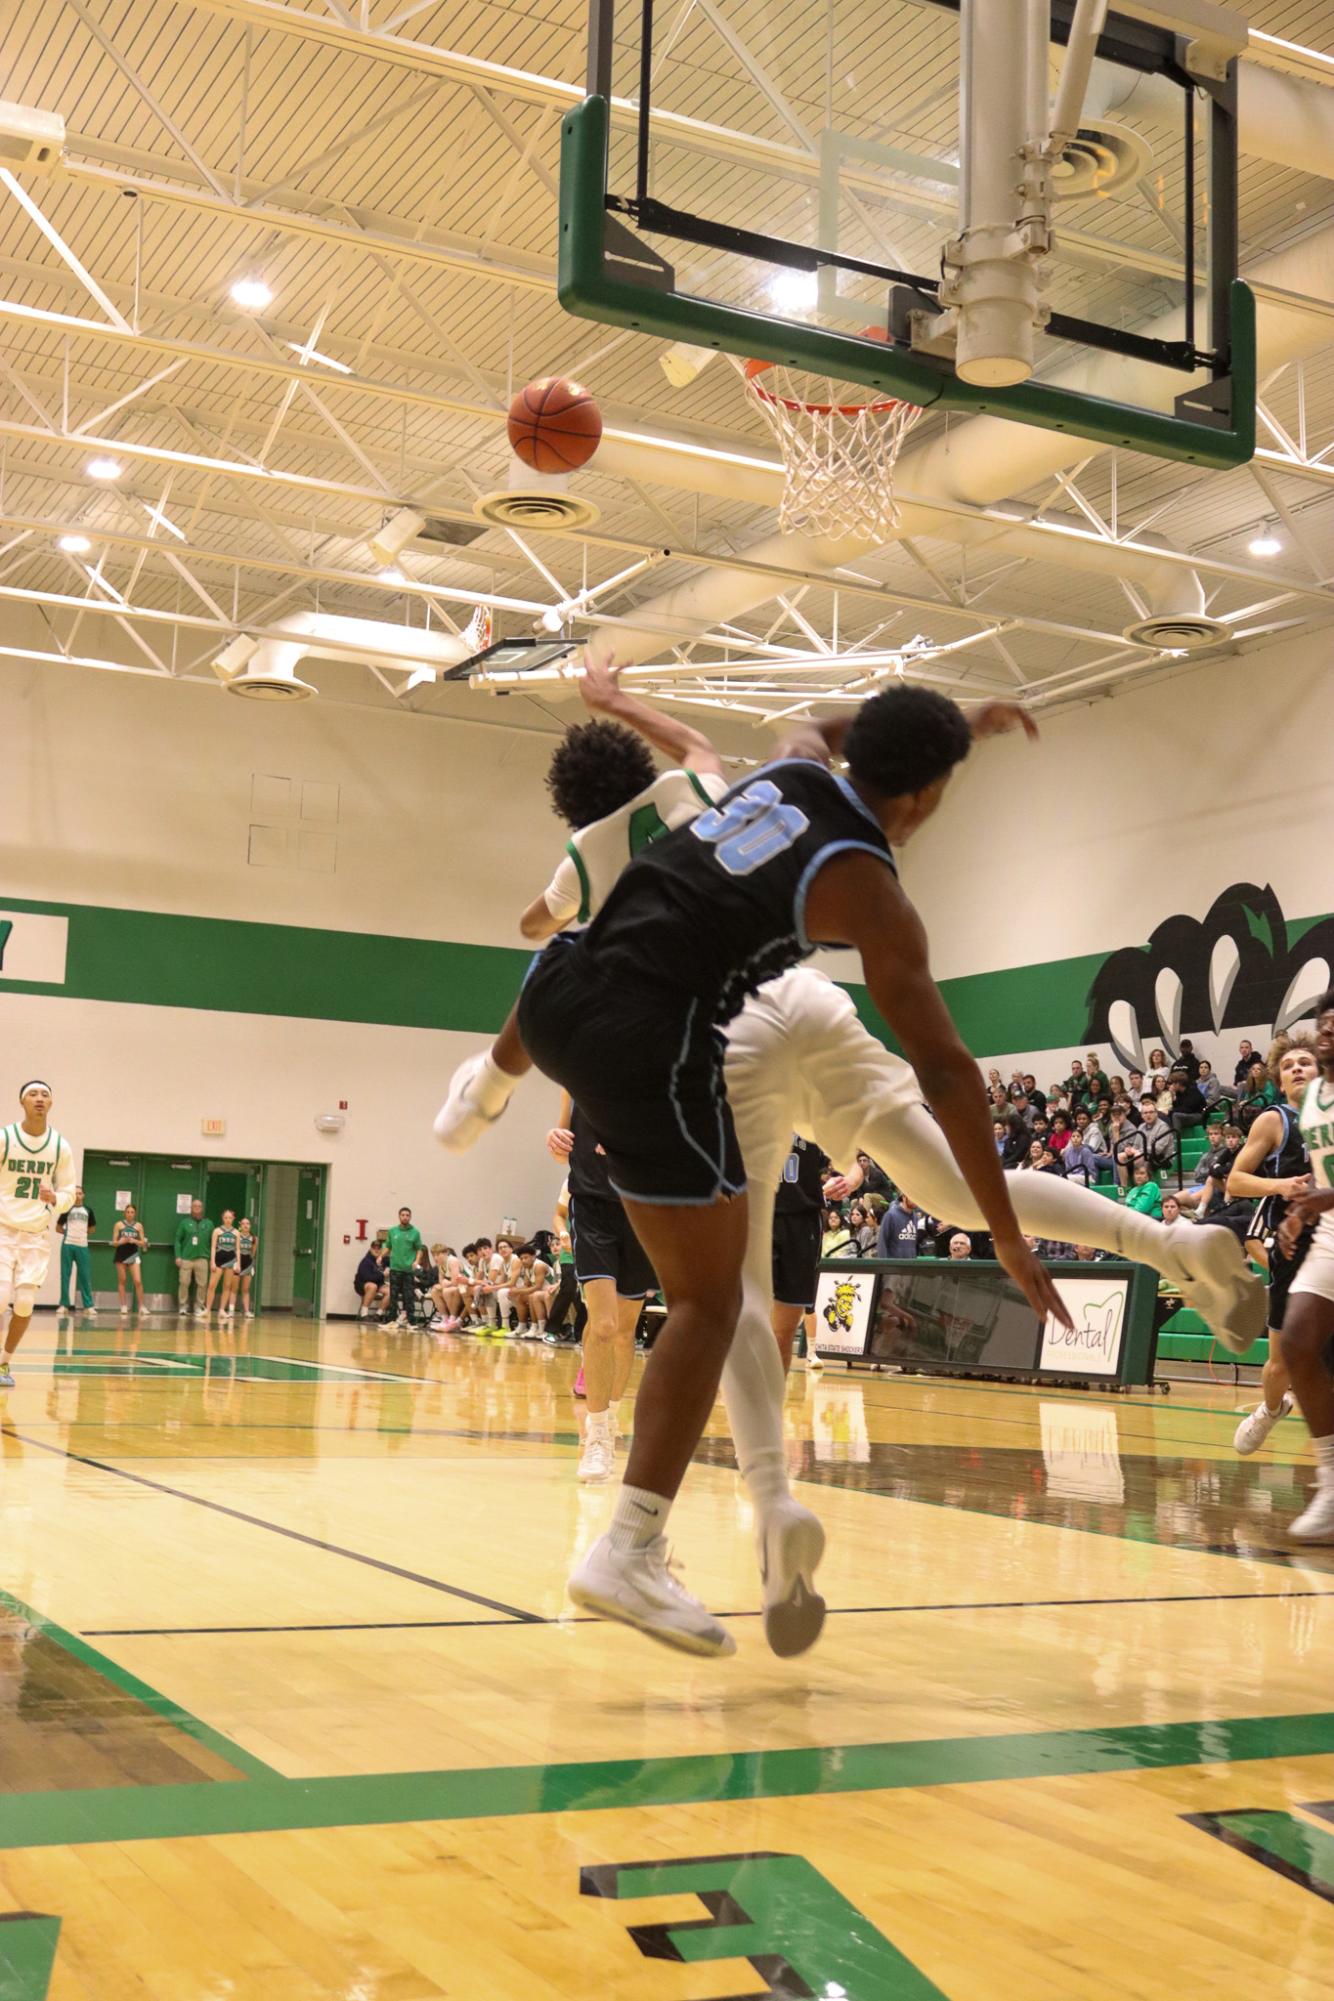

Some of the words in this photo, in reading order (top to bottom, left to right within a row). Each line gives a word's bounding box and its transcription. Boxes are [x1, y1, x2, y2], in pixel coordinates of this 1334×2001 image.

[689, 779, 811, 876] 30
[8, 1158, 54, 1175] DERBY
[14, 1176, 42, 1200] 21
[1047, 1308, 1113, 1356] Dental
